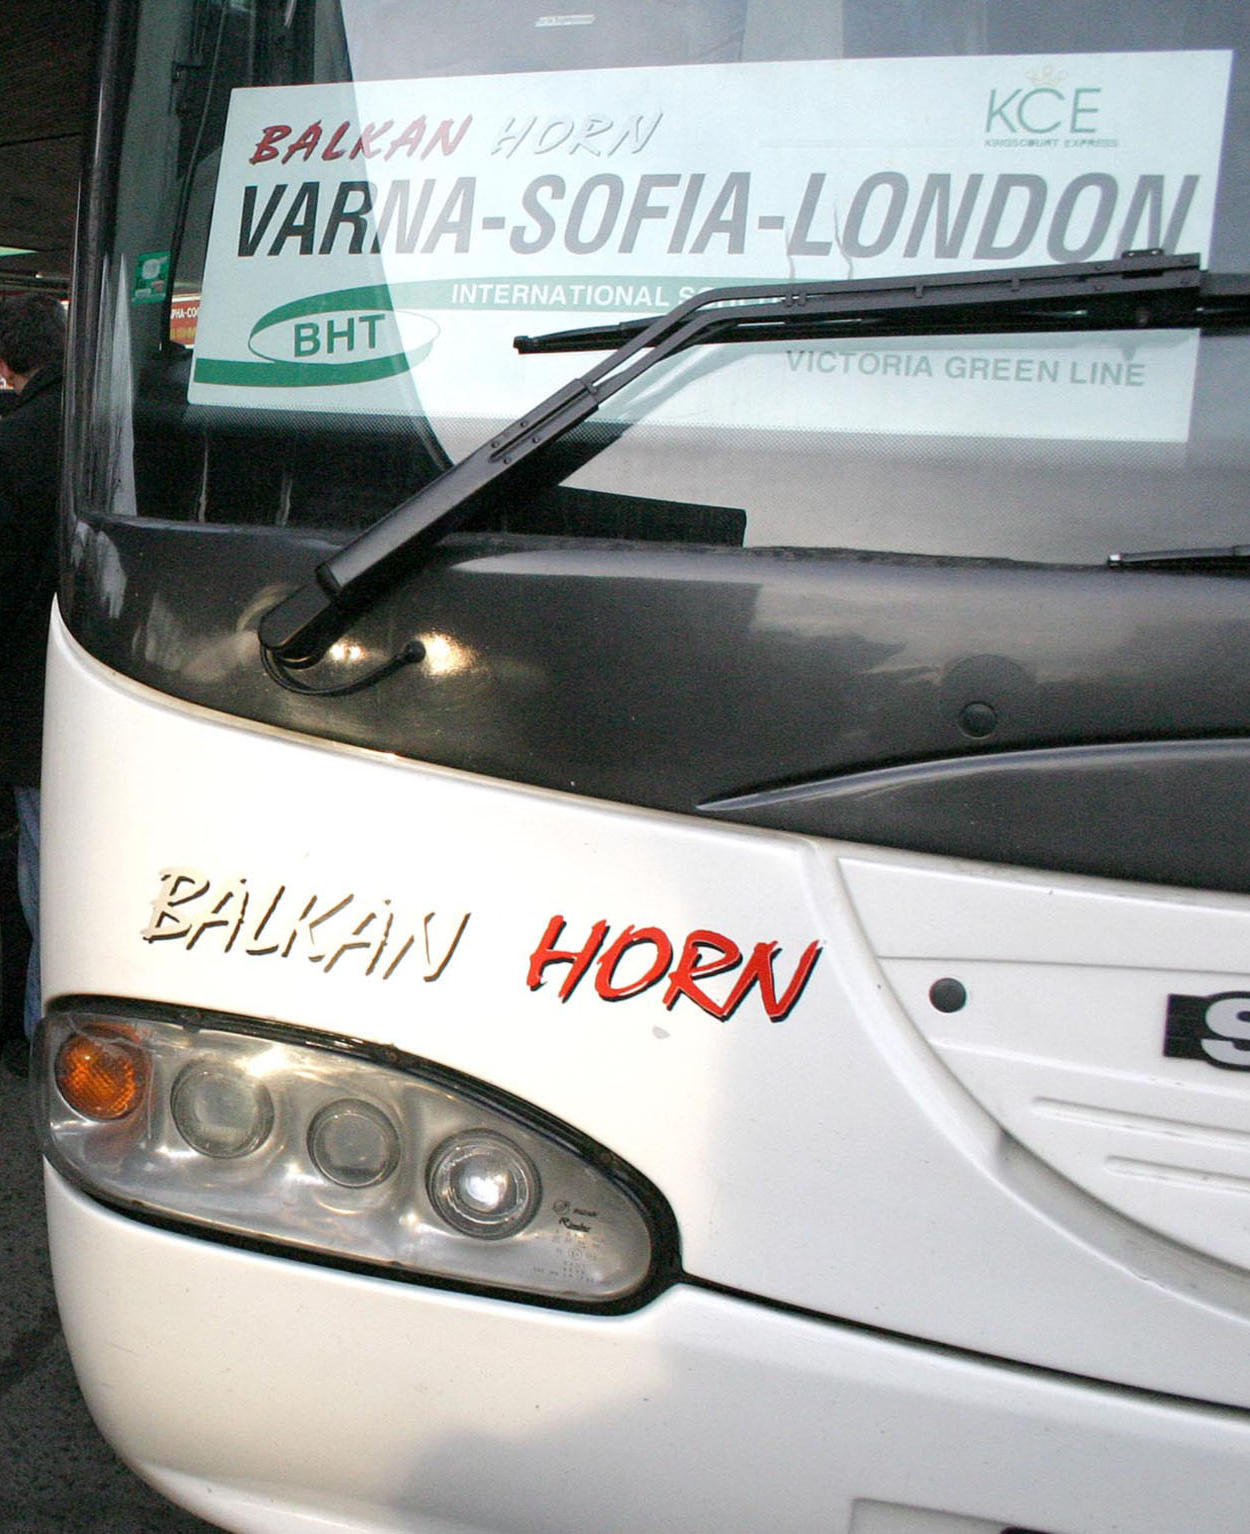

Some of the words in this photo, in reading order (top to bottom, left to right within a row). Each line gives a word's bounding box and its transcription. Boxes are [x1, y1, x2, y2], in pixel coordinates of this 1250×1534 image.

[984, 87, 1102, 134] KCE
[249, 113, 473, 166] BALKAN
[490, 112, 664, 160] HORN
[1063, 138, 1119, 149] EXPRESS
[236, 170, 1200, 261] VARNA-SOFIA-LONDON
[451, 283, 670, 308] INTERNATIONAL
[293, 314, 386, 357] BHT
[786, 350, 934, 378] VICTORIA
[944, 356, 1060, 383] GREEN
[1070, 361, 1146, 387] LINE
[142, 866, 471, 982] BALKAN
[526, 915, 822, 1023] HORN
